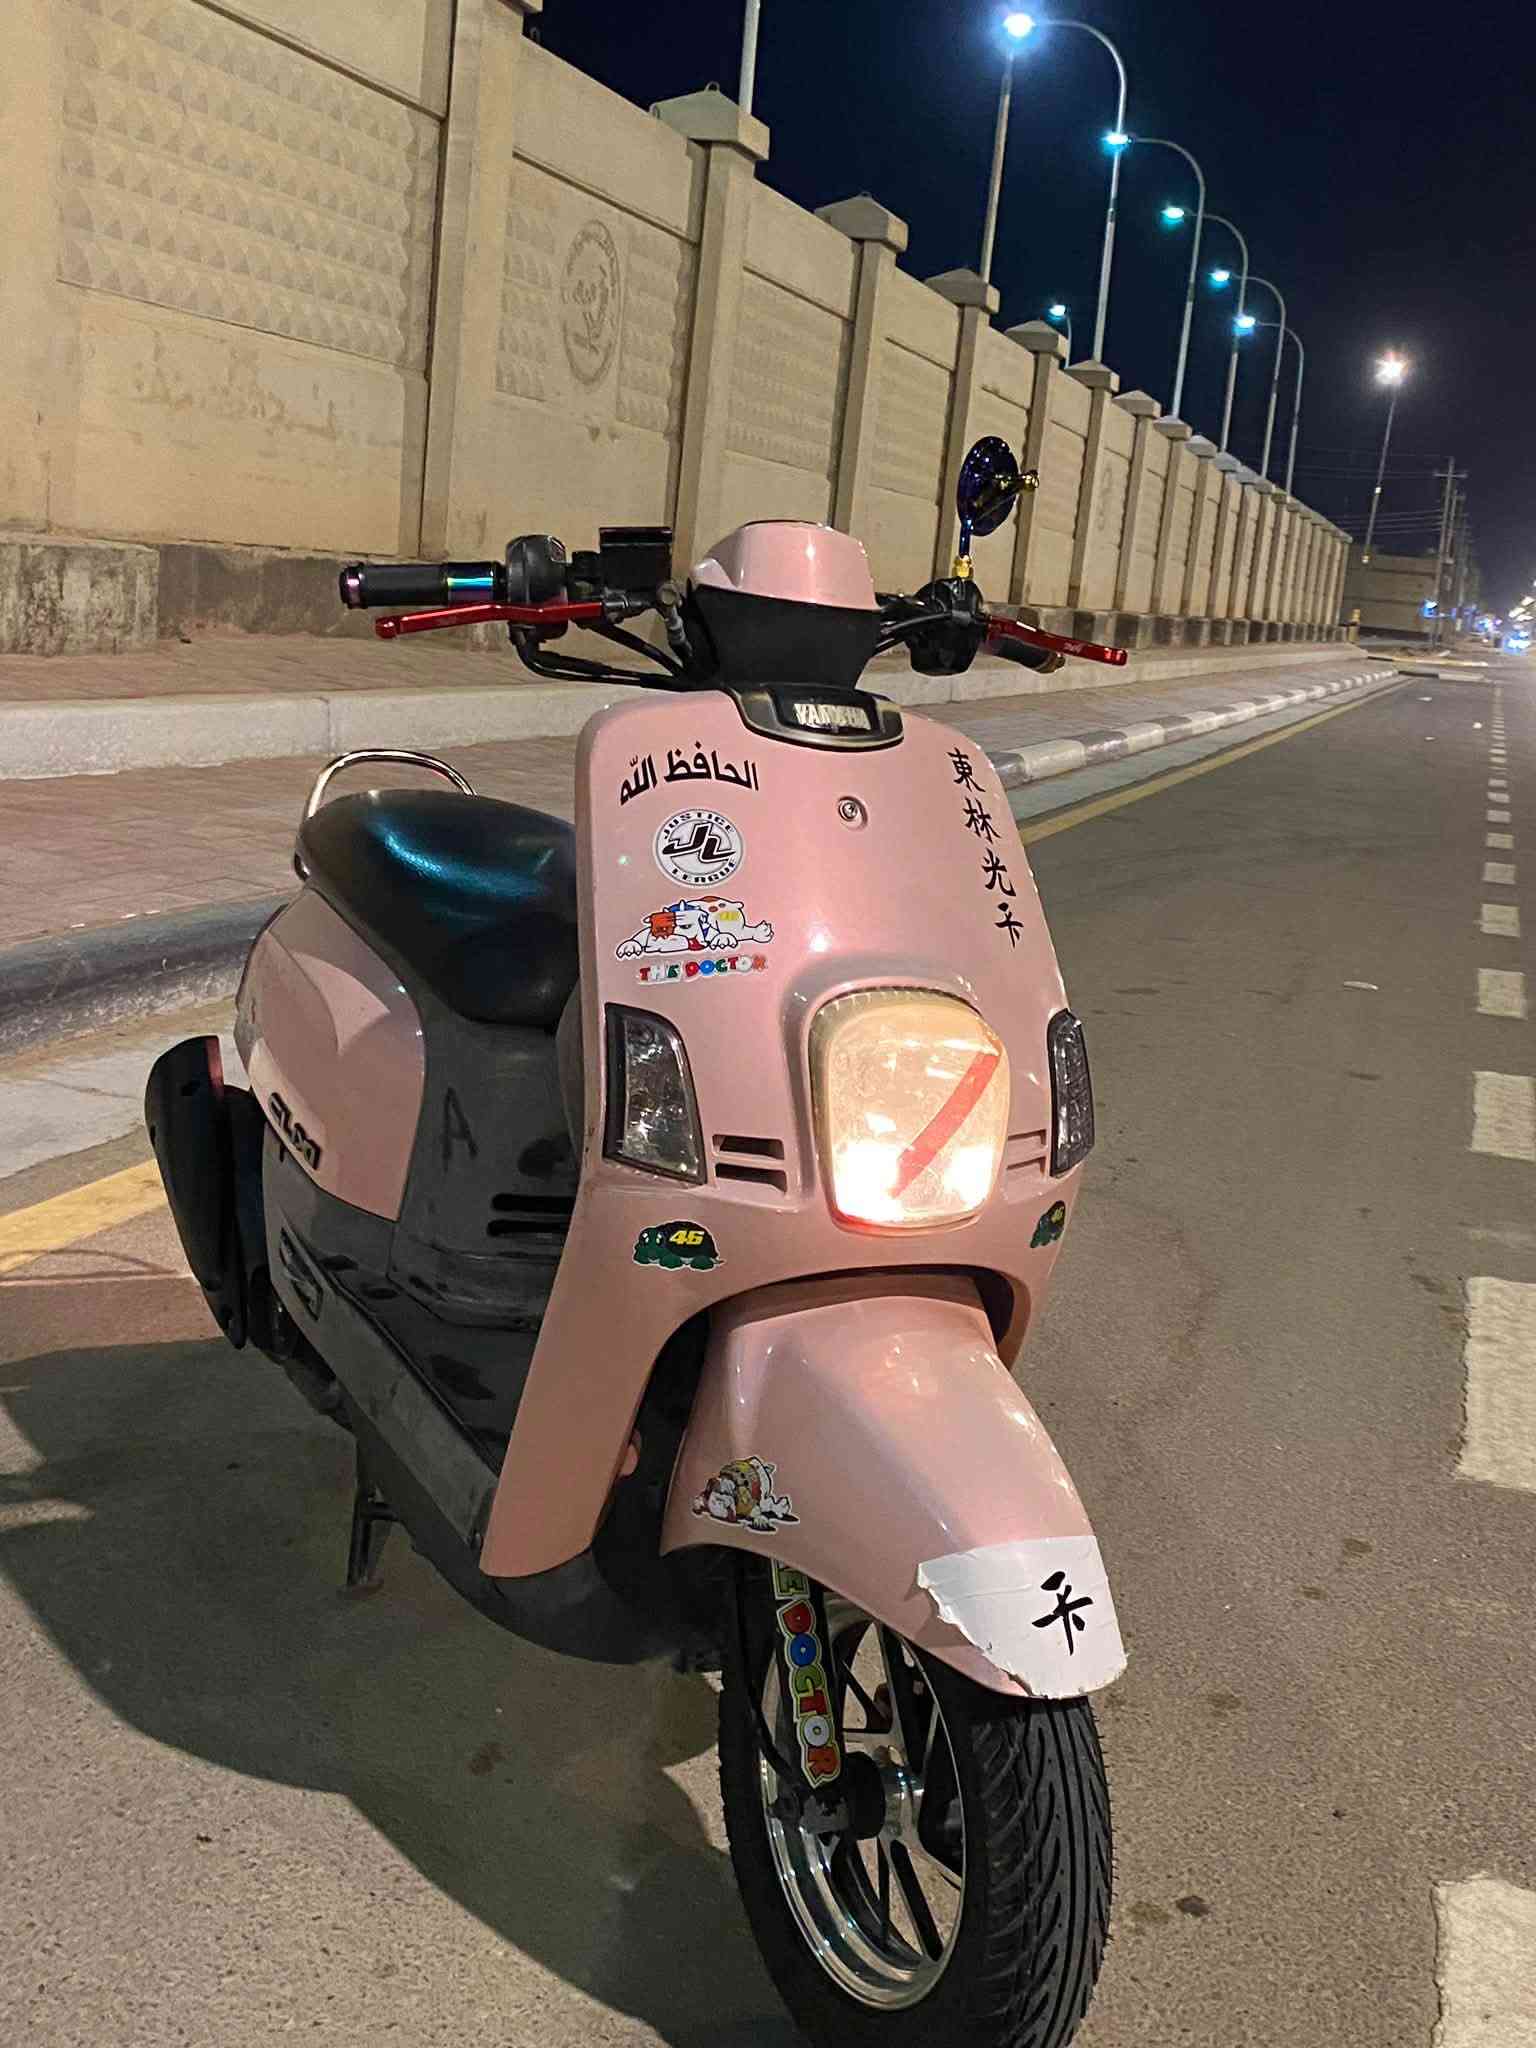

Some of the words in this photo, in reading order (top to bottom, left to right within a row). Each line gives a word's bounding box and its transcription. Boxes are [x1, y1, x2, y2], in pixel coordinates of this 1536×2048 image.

[663, 741, 759, 791] الحافظ
[639, 963, 680, 982] THE
[684, 954, 767, 977] DOCTOR
[668, 1230, 705, 1245] 46
[778, 1601, 840, 1785] DOCTOR
